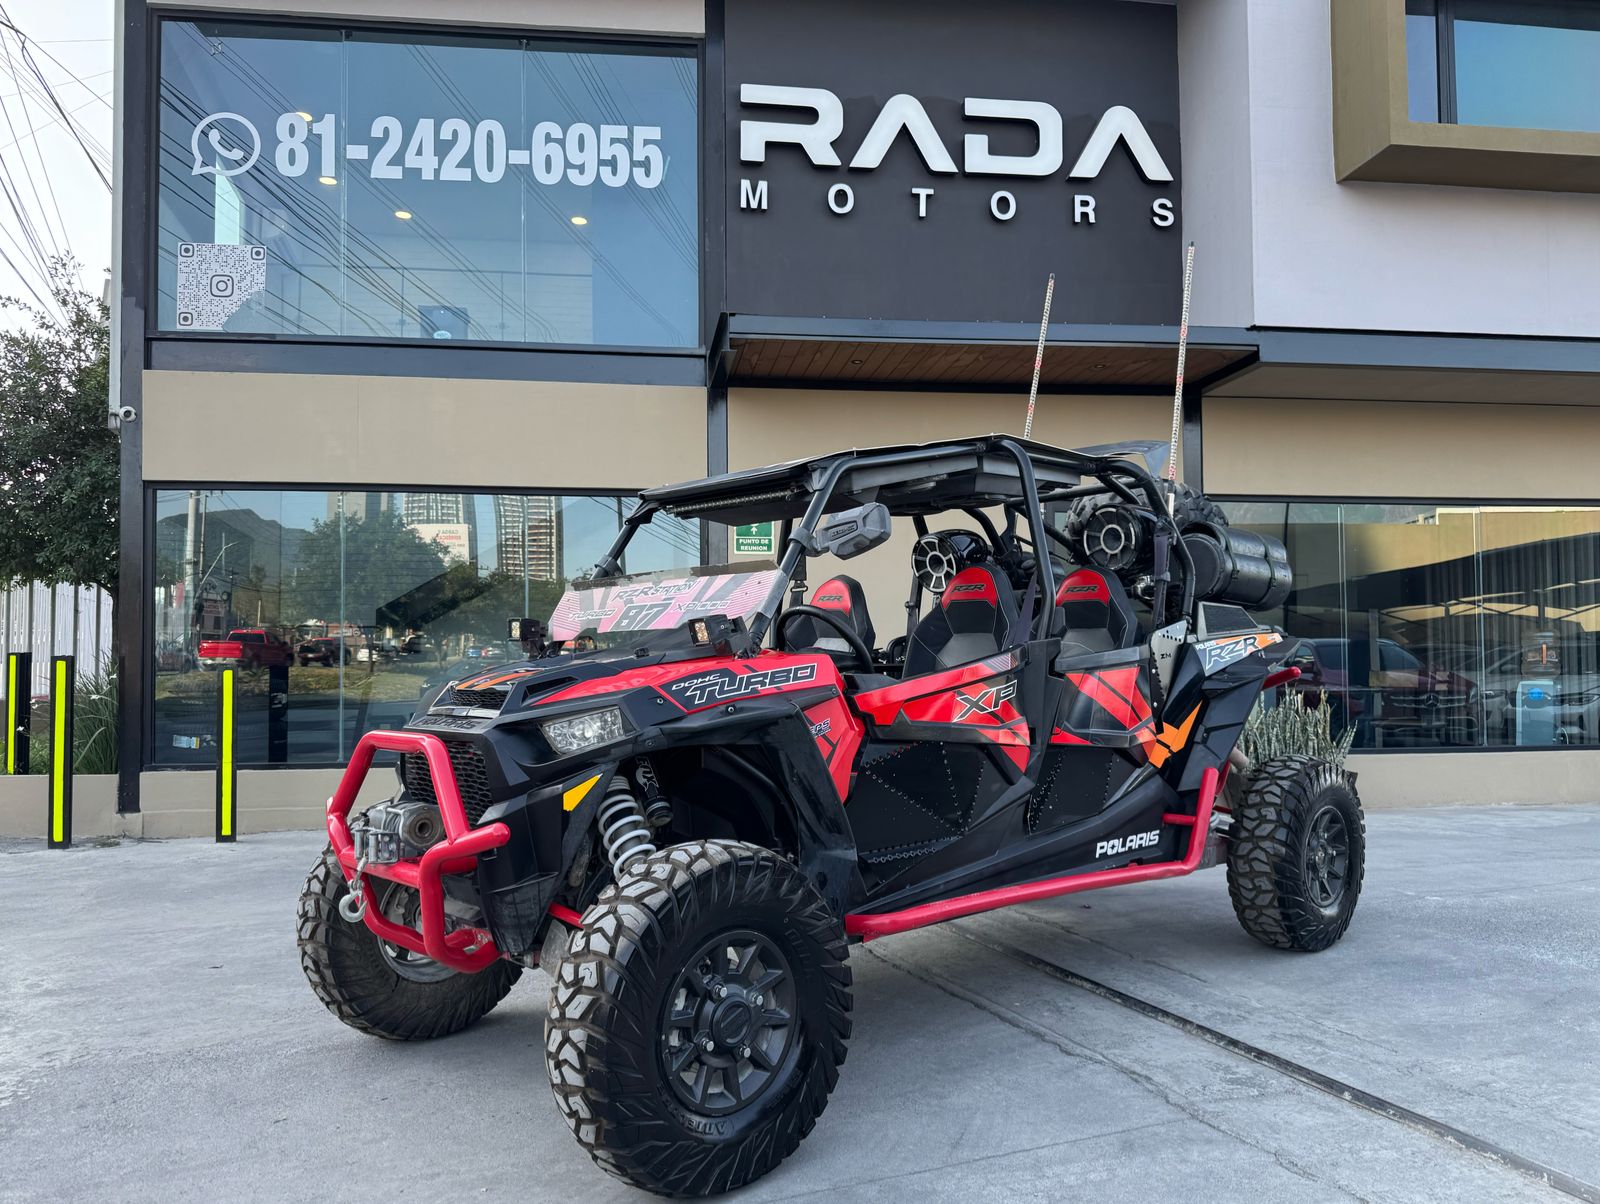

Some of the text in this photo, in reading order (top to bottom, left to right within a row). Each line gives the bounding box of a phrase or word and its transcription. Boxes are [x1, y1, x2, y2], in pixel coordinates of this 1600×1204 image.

[275, 112, 666, 189] 81-2420-6955
[740, 83, 1174, 182] RADA
[740, 179, 1175, 227] MOTORS
[952, 583, 986, 593] RZR
[1065, 585, 1099, 594] RZR
[1205, 634, 1260, 671] RZR
[672, 673, 721, 691] DOHC
[685, 663, 818, 705] TURBO
[952, 680, 1018, 723] XP
[1095, 829, 1160, 858] POLARIS
